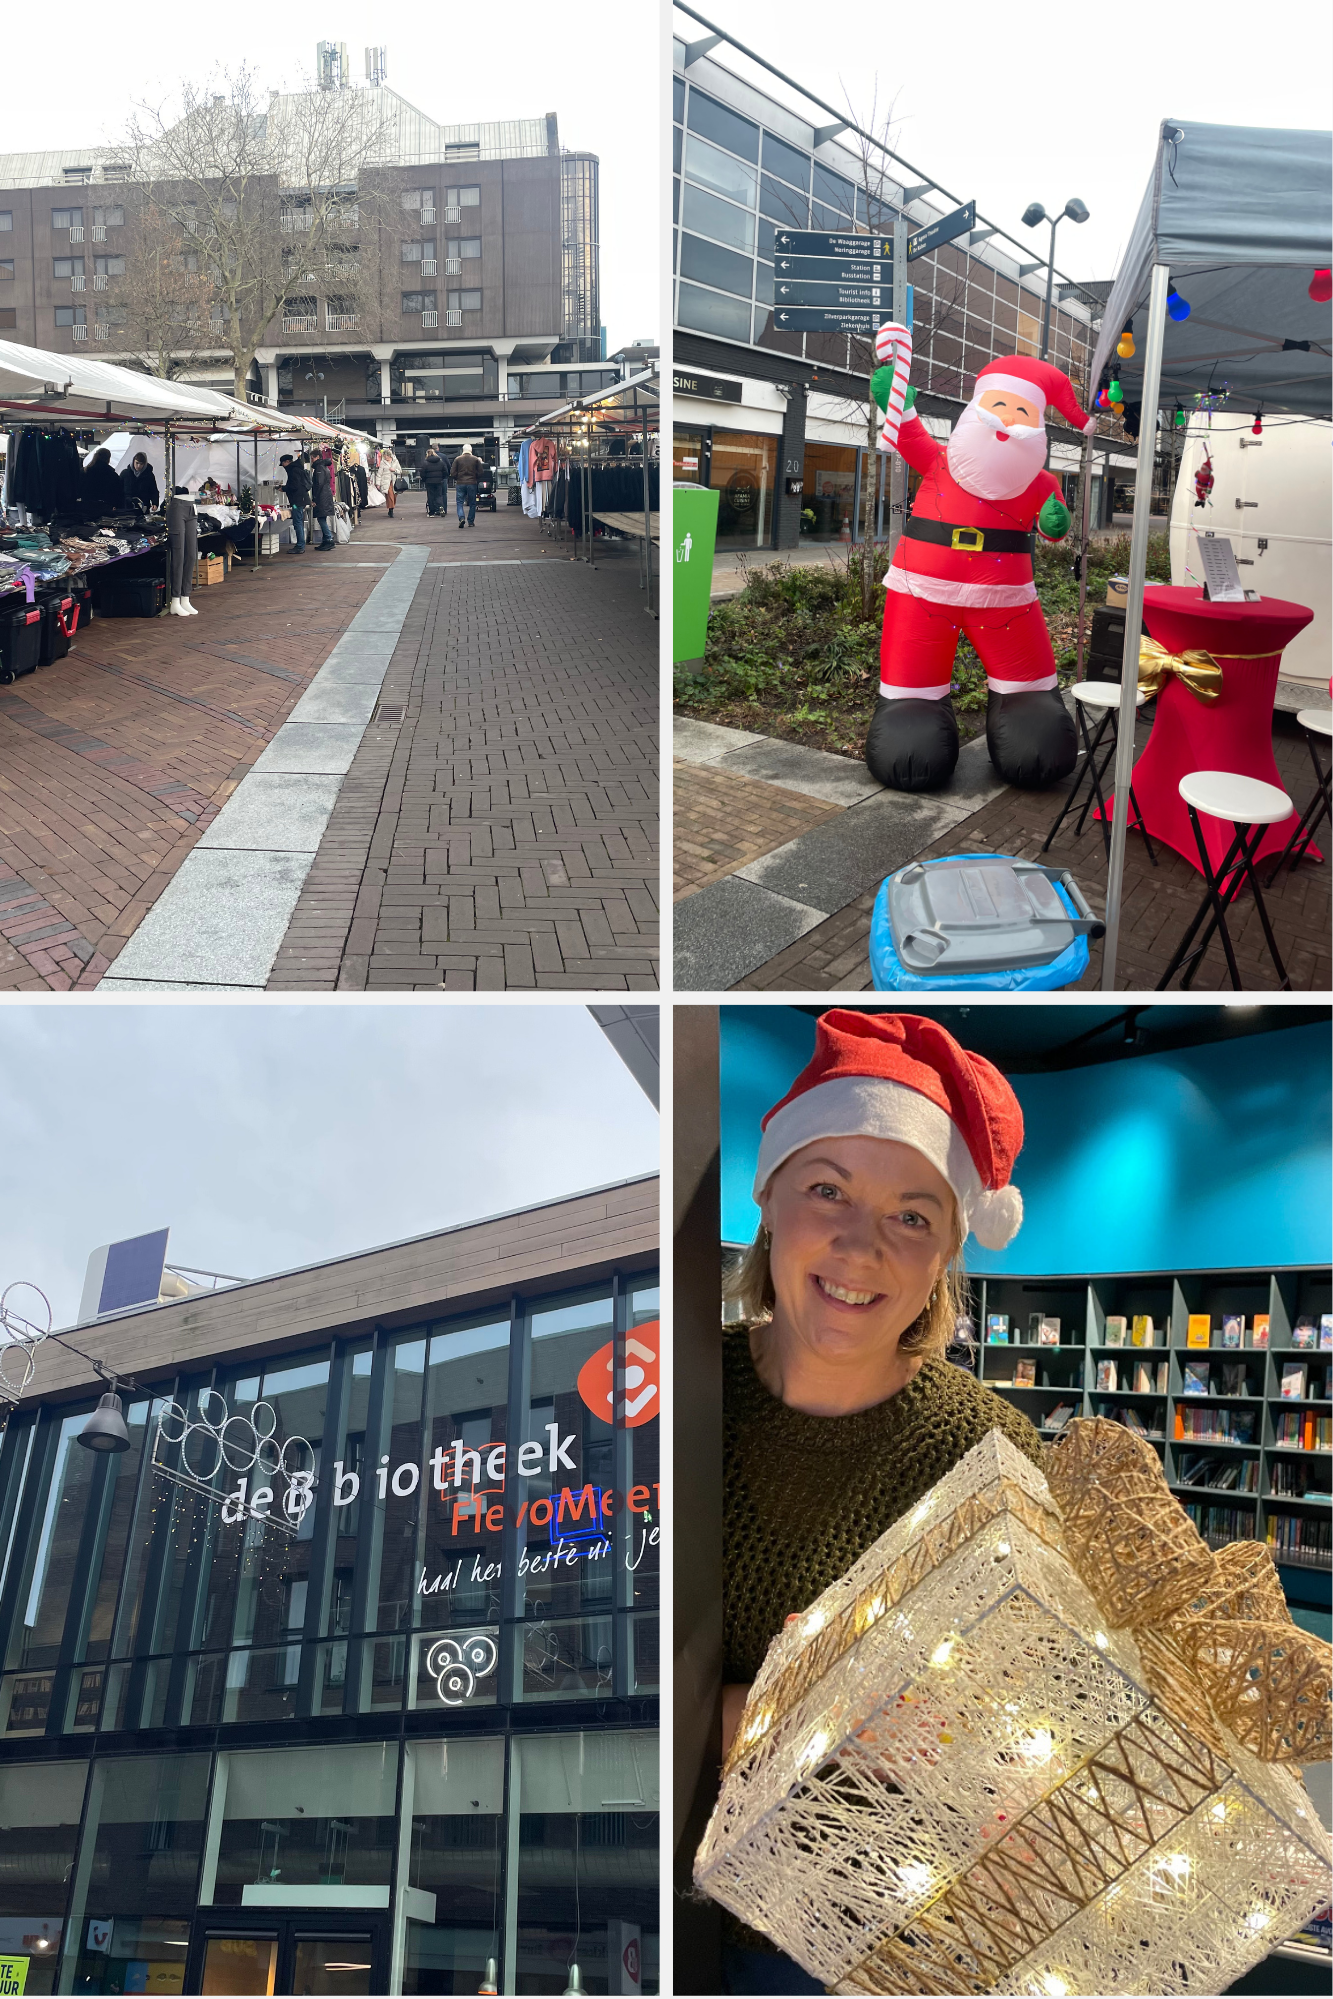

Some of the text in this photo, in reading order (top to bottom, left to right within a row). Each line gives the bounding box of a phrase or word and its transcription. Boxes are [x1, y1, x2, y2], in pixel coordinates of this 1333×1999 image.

[838, 287, 871, 296] Tourist info
[839, 296, 871, 304] Bibliotheek
[823, 313, 871, 322] Zilverparkgarage
[840, 322, 871, 330] Ziekenhuis
[673, 377, 698, 391] SINE
[785, 460, 799, 473] 20
[417, 1559, 462, 1595] haal
[517, 1537, 579, 1577] beste
[1, 1964, 13, 1979] TE
